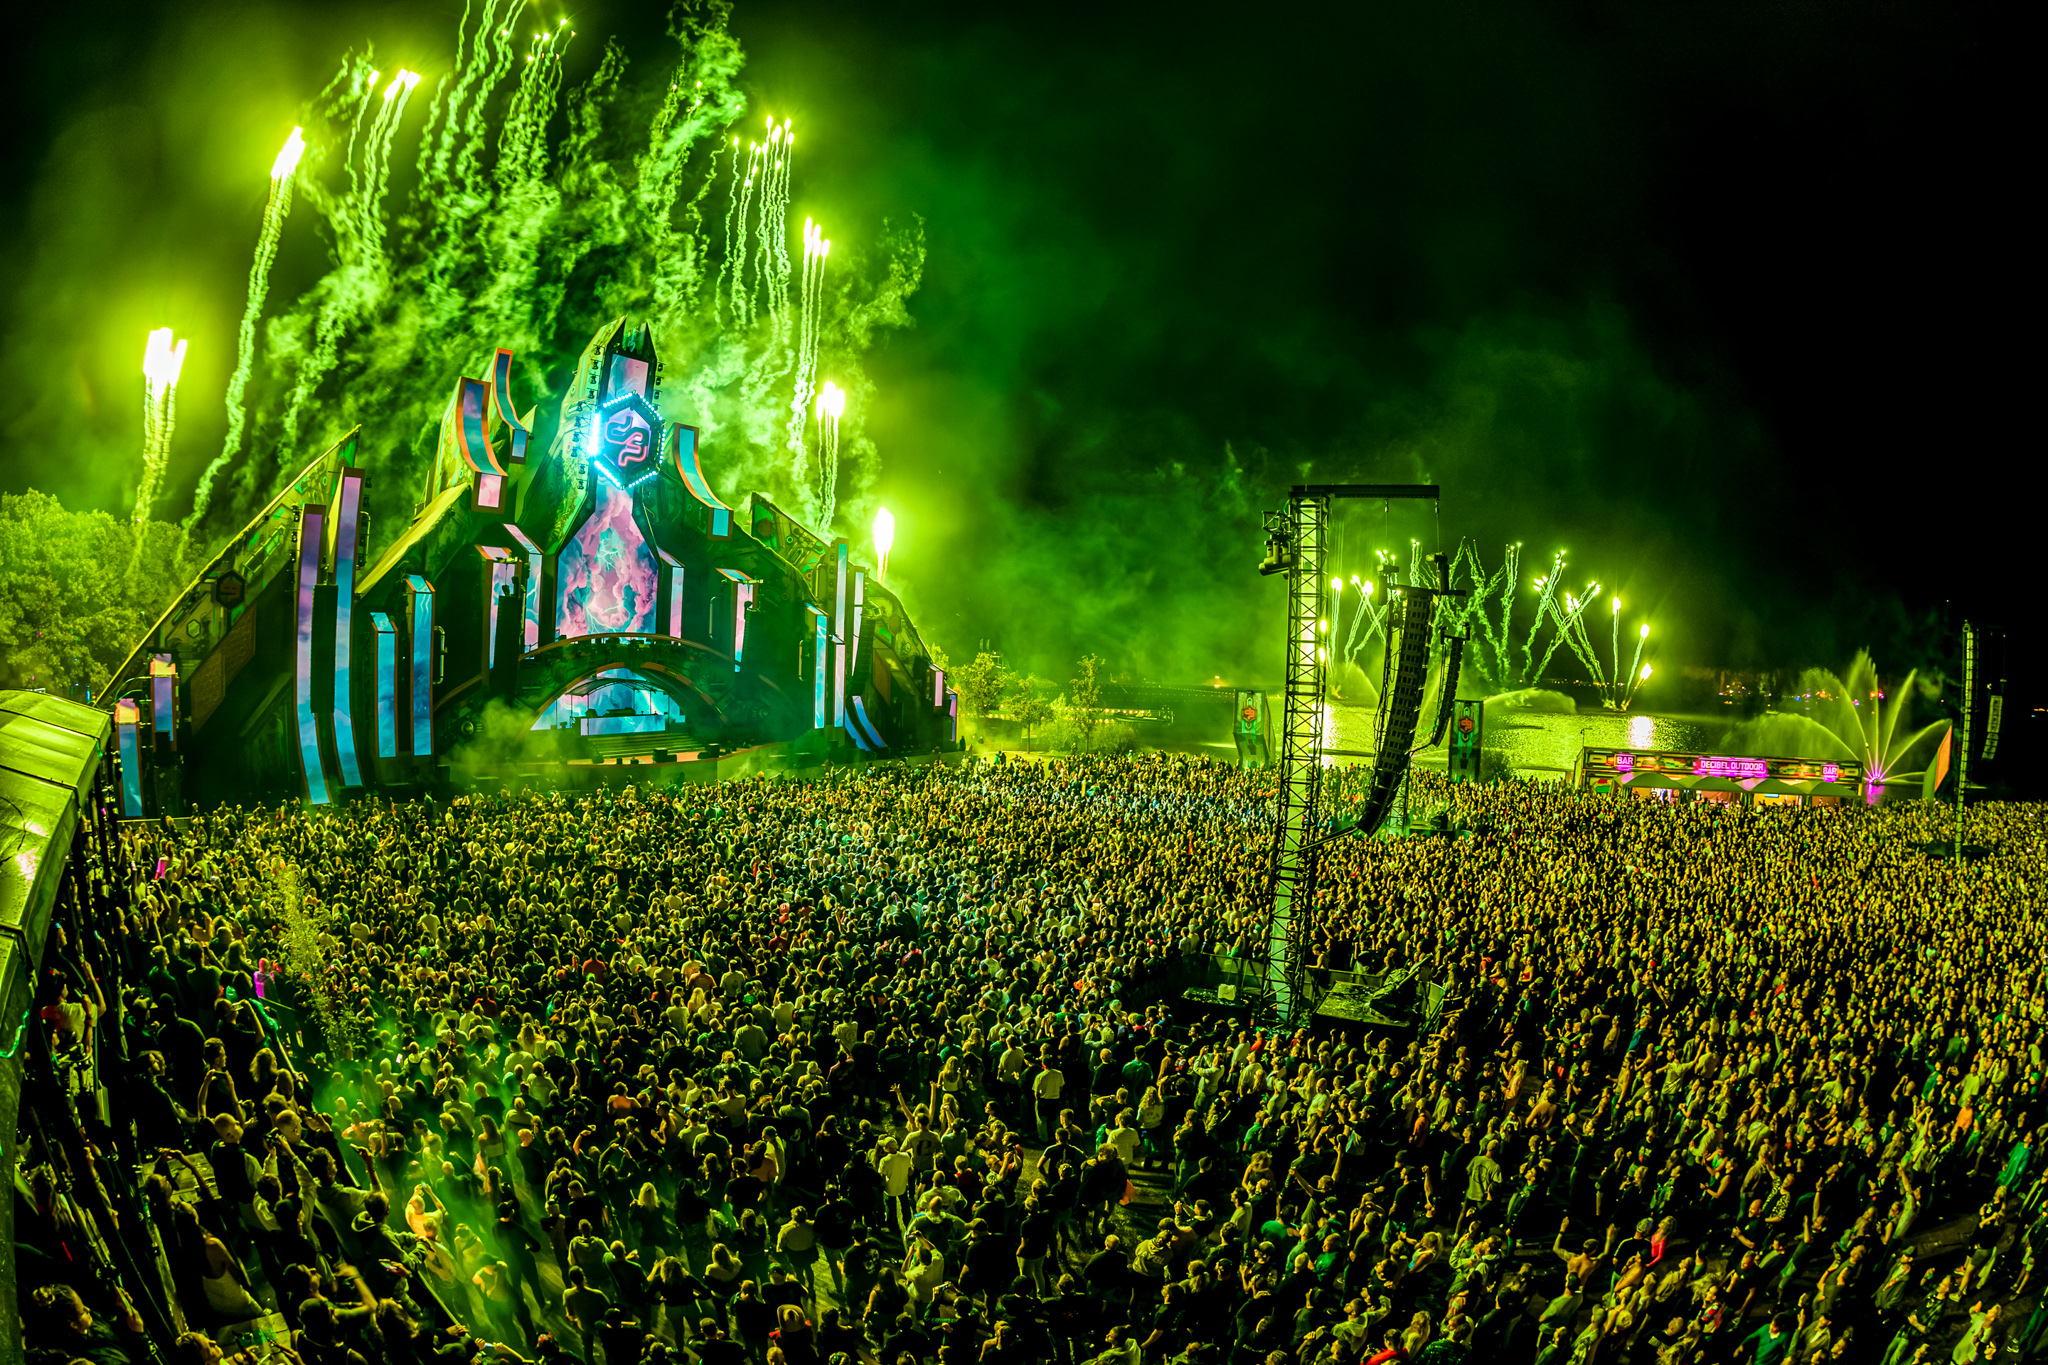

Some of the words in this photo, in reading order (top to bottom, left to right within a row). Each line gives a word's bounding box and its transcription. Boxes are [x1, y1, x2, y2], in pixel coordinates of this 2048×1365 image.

[1617, 756, 1633, 764] BAR
[1700, 761, 1729, 769] DECIBEL
[1731, 762, 1763, 771] OUTDOOR
[1823, 766, 1837, 775] BAR
